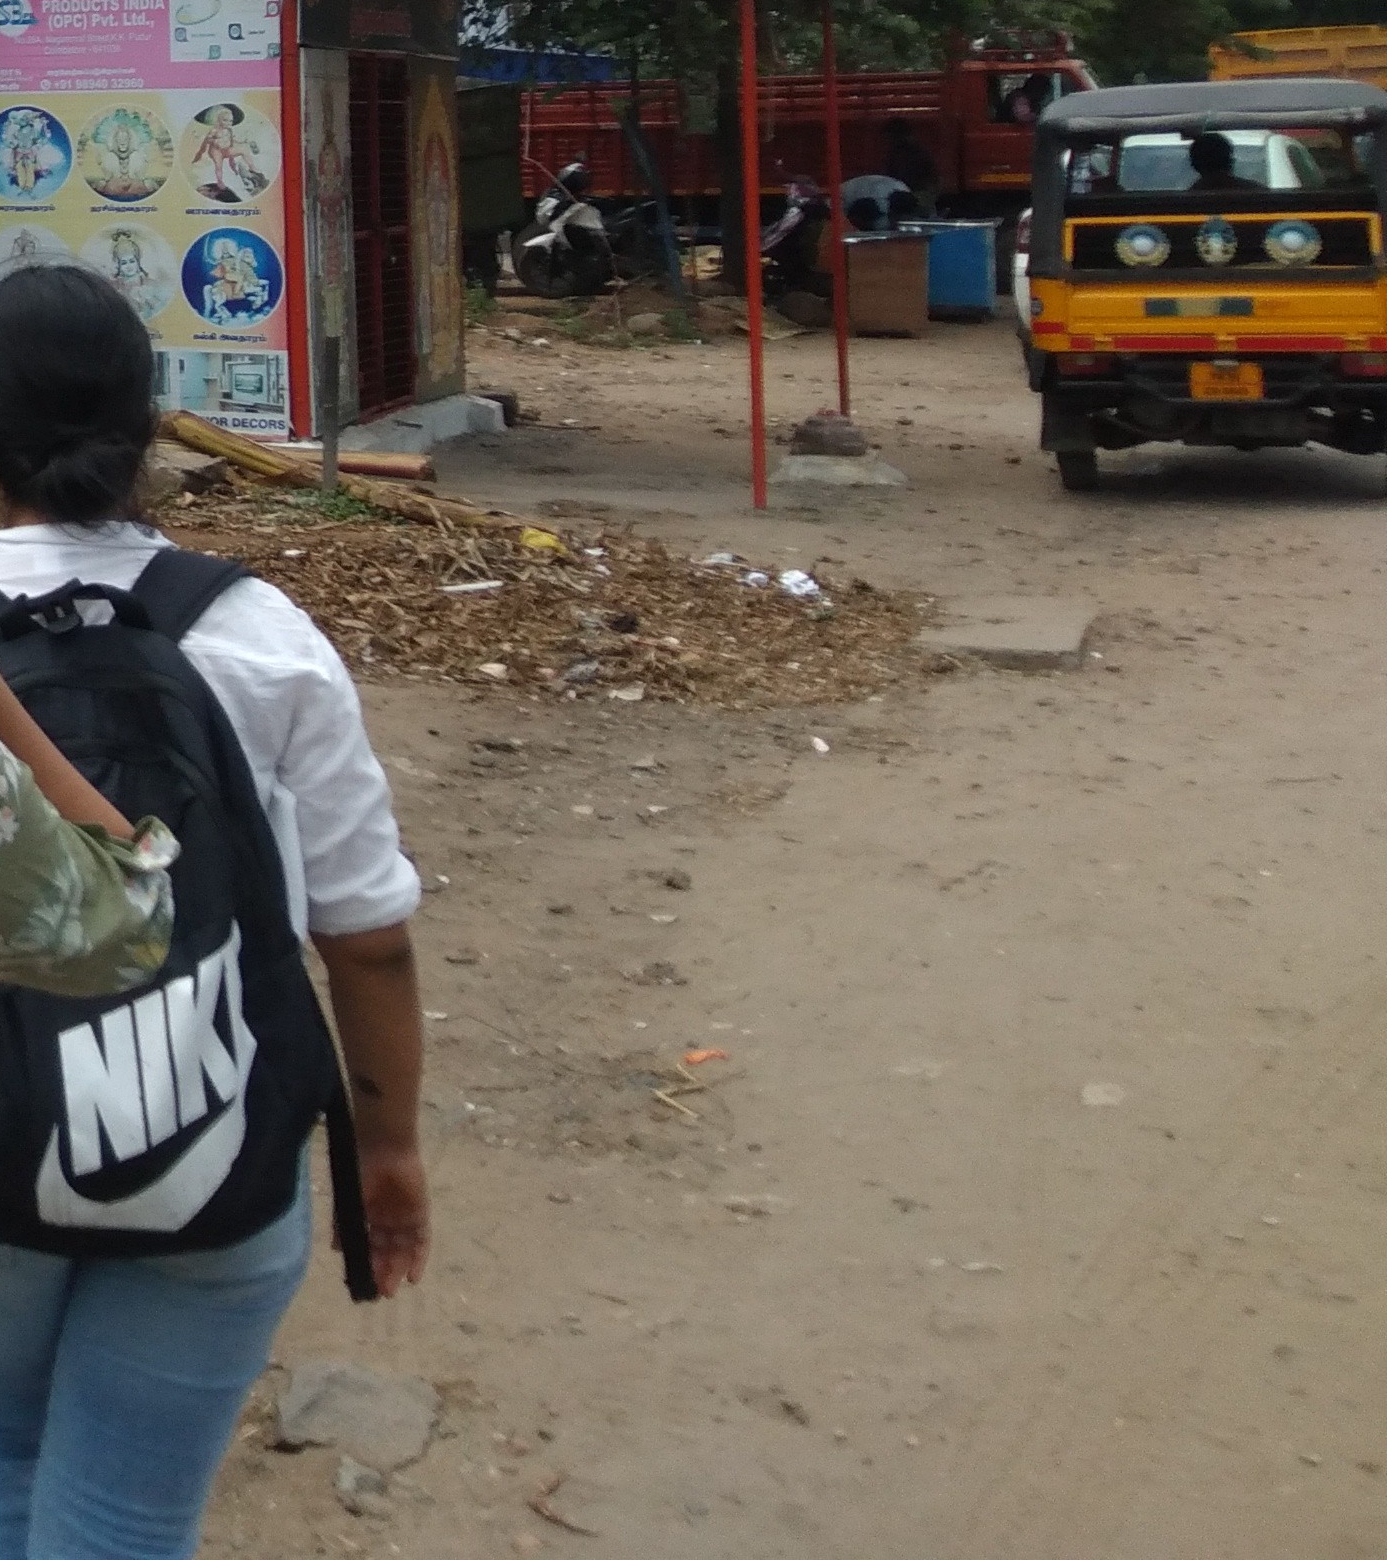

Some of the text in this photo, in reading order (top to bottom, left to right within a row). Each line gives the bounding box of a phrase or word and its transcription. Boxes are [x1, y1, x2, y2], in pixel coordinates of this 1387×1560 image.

[48, 12, 88, 31] (OPC)
[91, 11, 119, 28] Pvt.
[231, 417, 286, 430] DECORS
[58, 924, 249, 1178] NIK
